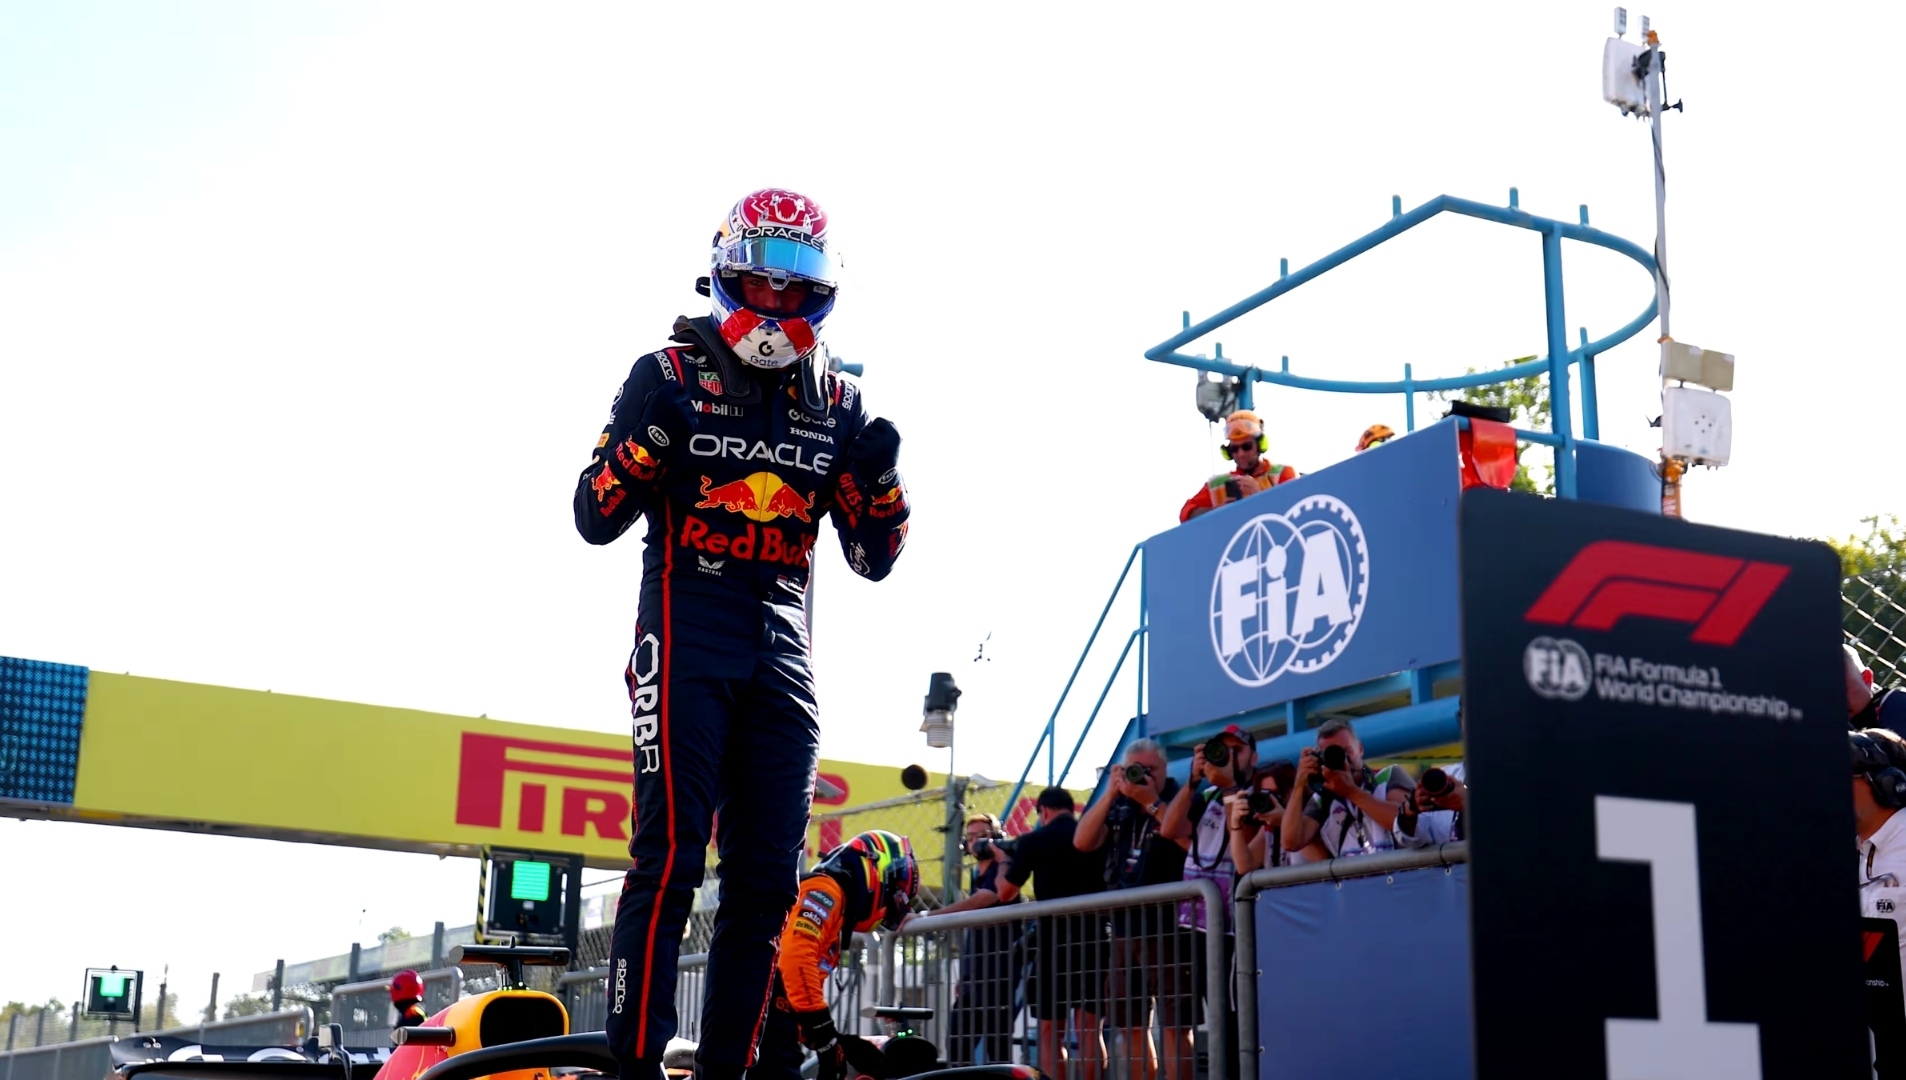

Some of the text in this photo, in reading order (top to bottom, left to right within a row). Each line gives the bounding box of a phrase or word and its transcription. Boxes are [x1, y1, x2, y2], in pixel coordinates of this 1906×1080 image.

[745, 226, 823, 251] ORACLE
[750, 355, 778, 367] Gate
[700, 380, 722, 395] HEU
[701, 372, 720, 381] TA
[691, 400, 728, 416] Mobil
[789, 426, 835, 445] HONDA
[615, 441, 634, 470] Red
[689, 433, 834, 476] ORACLE
[680, 514, 756, 561] Red
[1594, 652, 1723, 688] FIA Formula 1
[1596, 676, 1655, 702] World
[631, 632, 660, 774] ORBR
[802, 911, 821, 926] okta
[1594, 794, 1764, 1080] 1
[612, 957, 628, 1015] sparco
